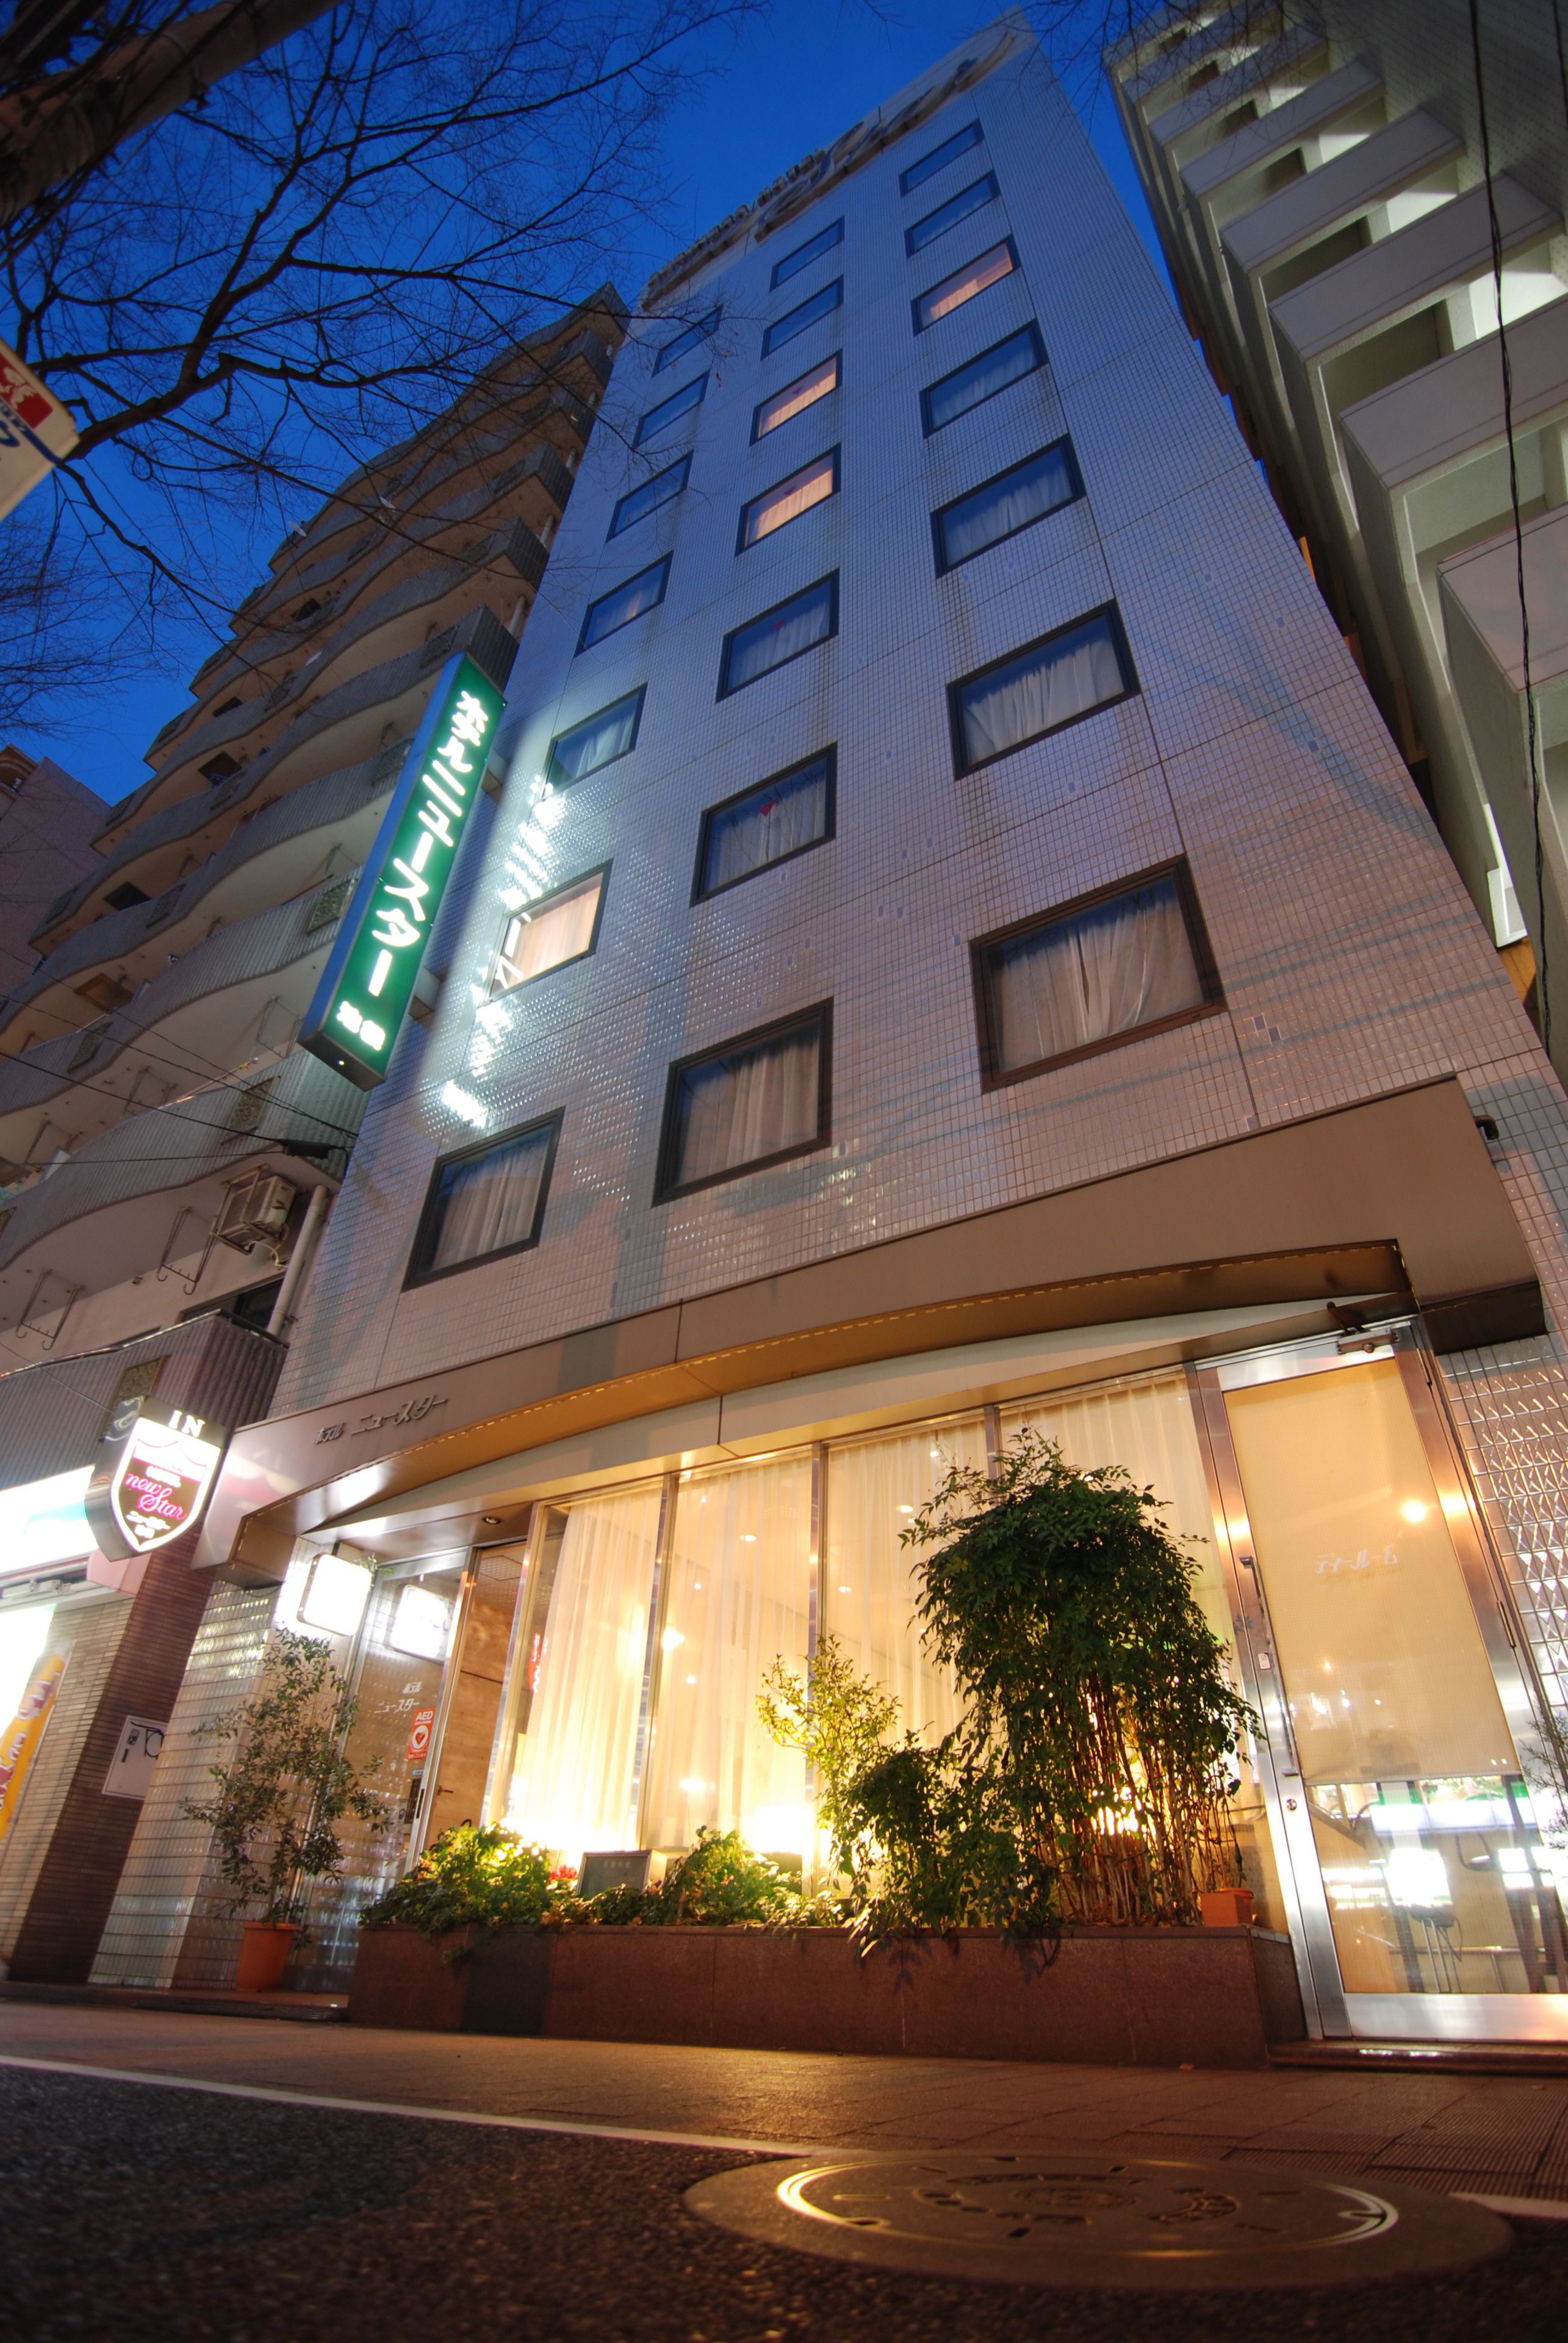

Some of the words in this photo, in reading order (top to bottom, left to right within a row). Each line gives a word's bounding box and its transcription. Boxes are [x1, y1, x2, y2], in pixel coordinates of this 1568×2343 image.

[168, 1409, 206, 1438] IN
[351, 1395, 448, 1435] ニュースター
[124, 1473, 162, 1494] new
[137, 1488, 187, 1521] Star
[415, 1710, 433, 1721] AED
